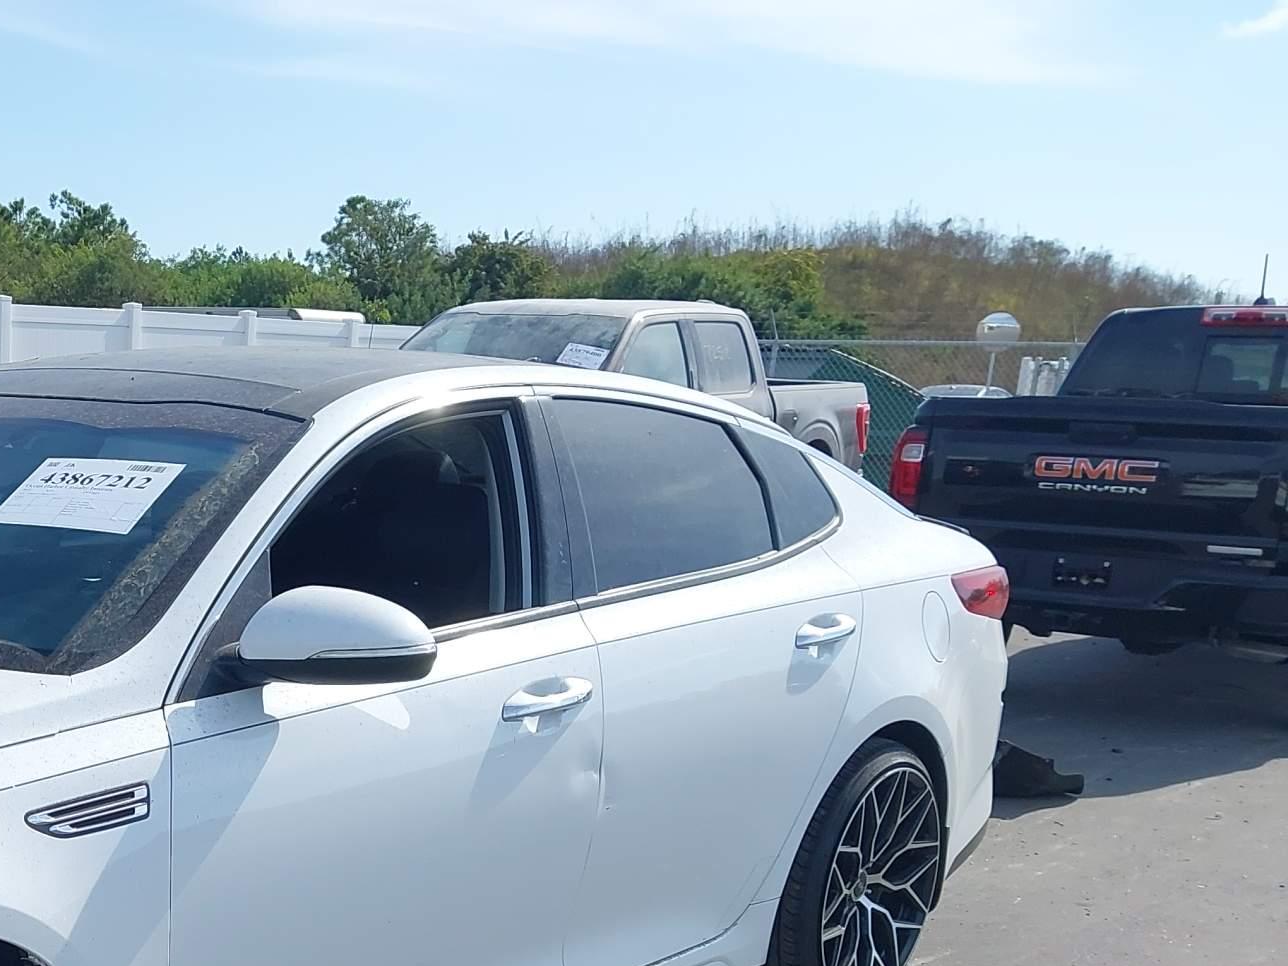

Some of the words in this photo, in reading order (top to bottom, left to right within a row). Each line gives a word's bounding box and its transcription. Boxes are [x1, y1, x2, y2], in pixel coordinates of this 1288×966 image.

[1034, 455, 1160, 482] GMC
[39, 471, 153, 490] 43867212
[1037, 481, 1148, 495] CANYON
